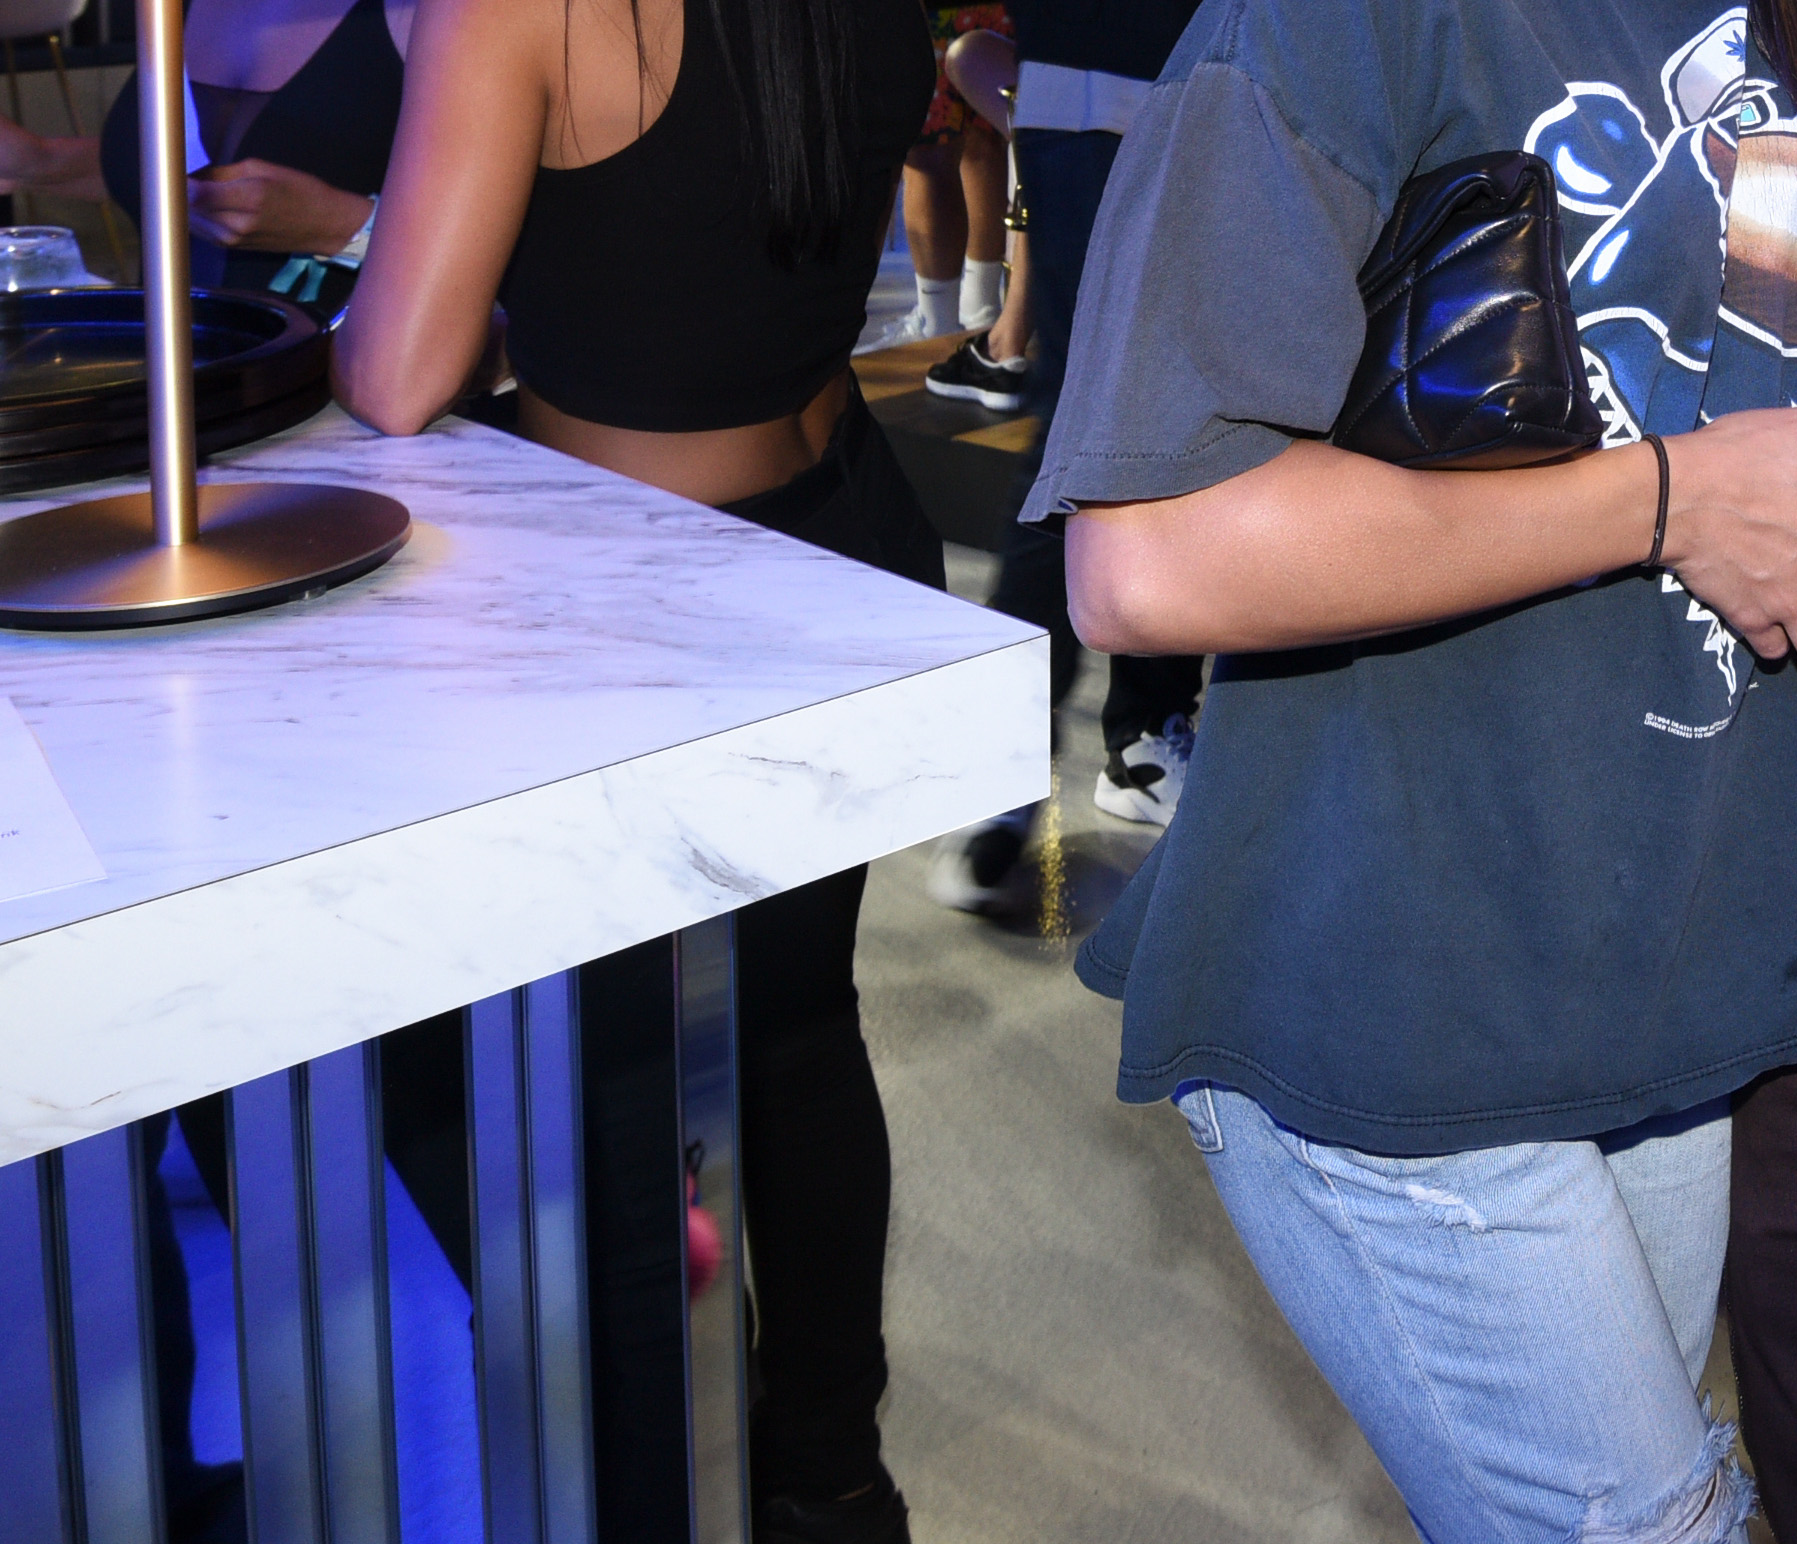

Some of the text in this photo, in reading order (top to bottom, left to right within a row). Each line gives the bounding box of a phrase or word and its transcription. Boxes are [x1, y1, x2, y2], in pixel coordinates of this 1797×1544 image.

[1644, 720, 1666, 731] UNDER
[1668, 726, 1692, 738] LICENSE
[1671, 721, 1692, 732] DEATH
